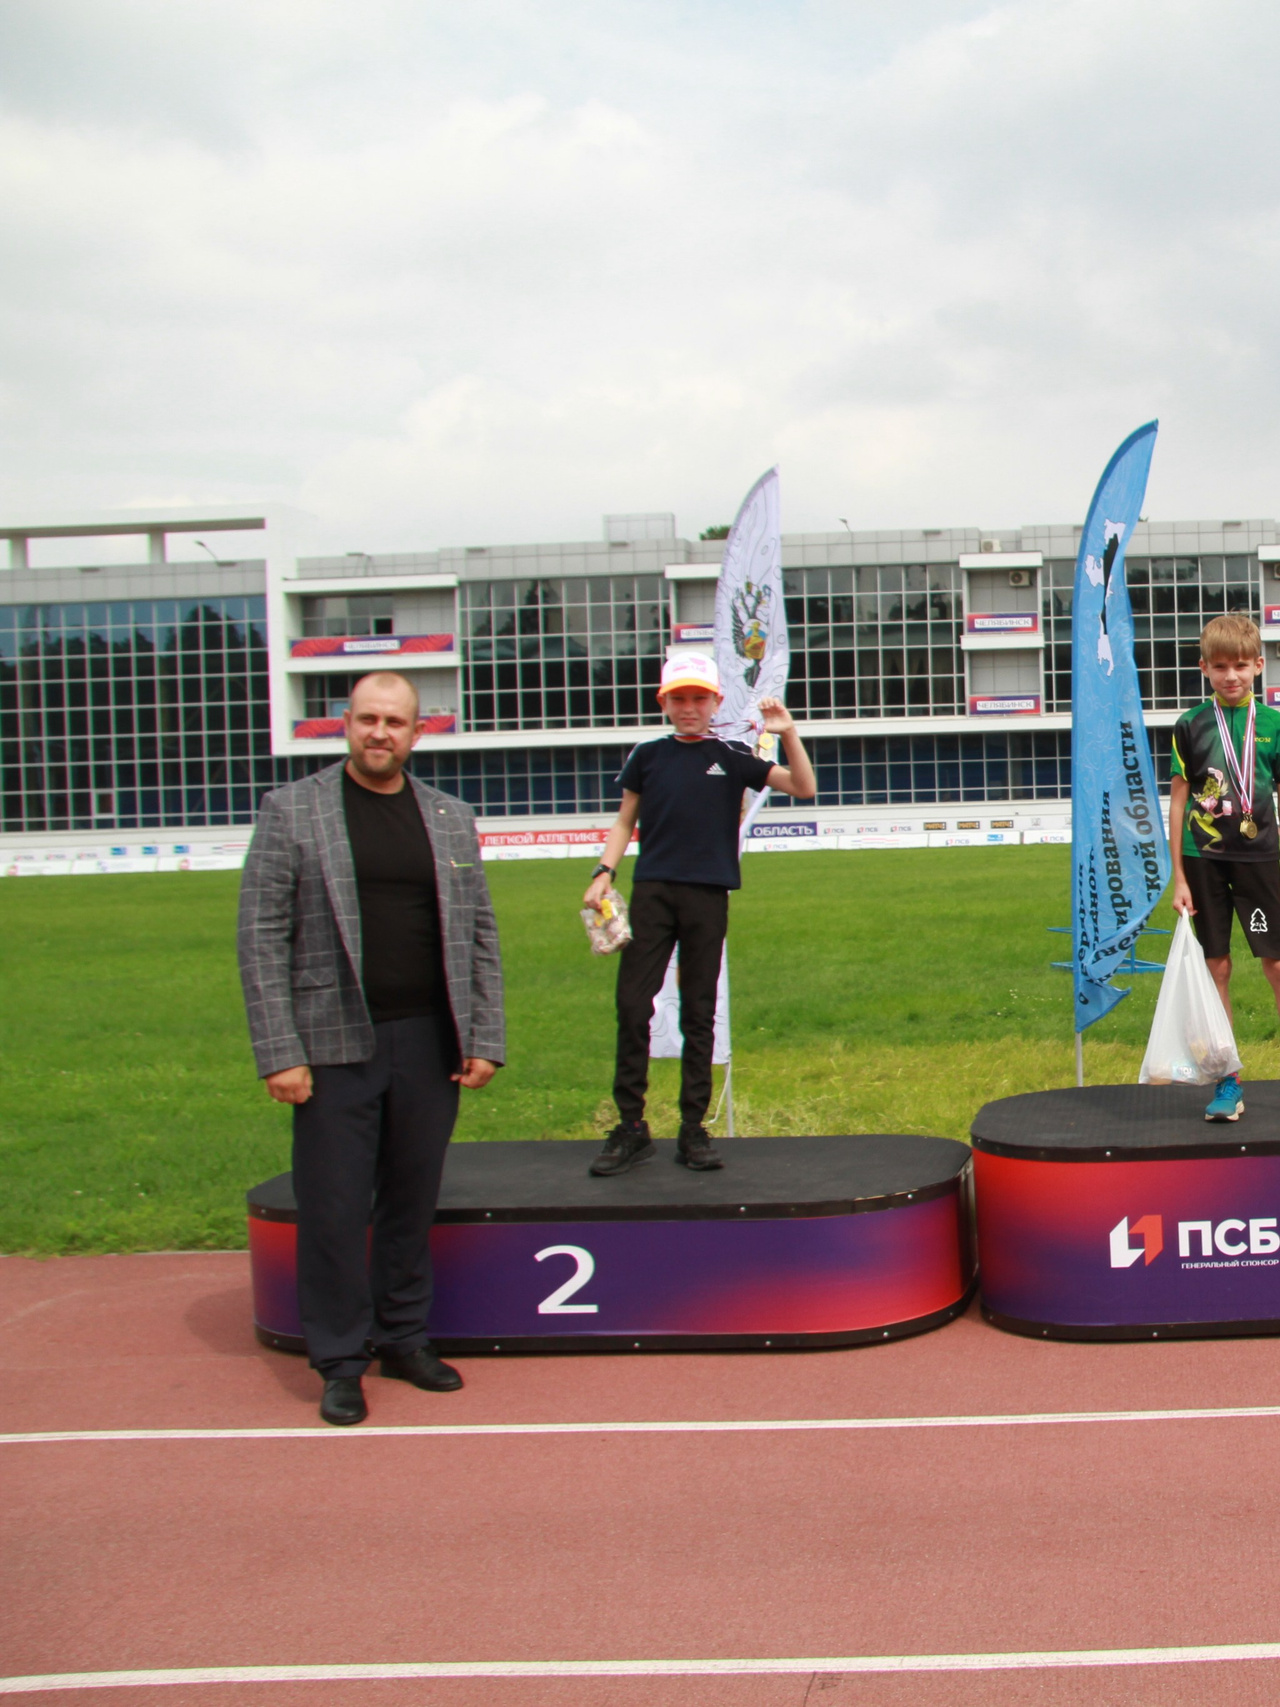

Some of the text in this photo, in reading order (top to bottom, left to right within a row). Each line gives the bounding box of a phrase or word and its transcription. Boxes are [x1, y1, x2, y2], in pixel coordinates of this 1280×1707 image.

[975, 618, 1031, 627] ЧЕЛЯБИНСК
[977, 700, 1033, 709] ЧЕЛЯБИНСК
[1119, 720, 1153, 838] области
[753, 825, 814, 836] ОБЛАСТЬ
[484, 832, 533, 845] ЛЕГКОЙ
[536, 831, 599, 844] АТЛЕТИКЕ
[1178, 1218, 1280, 1257] ПСБ
[1181, 1259, 1280, 1269] ГЕНЕРАЛЬНЫЙ СПОНСОР
[534, 1244, 599, 1314] 2
